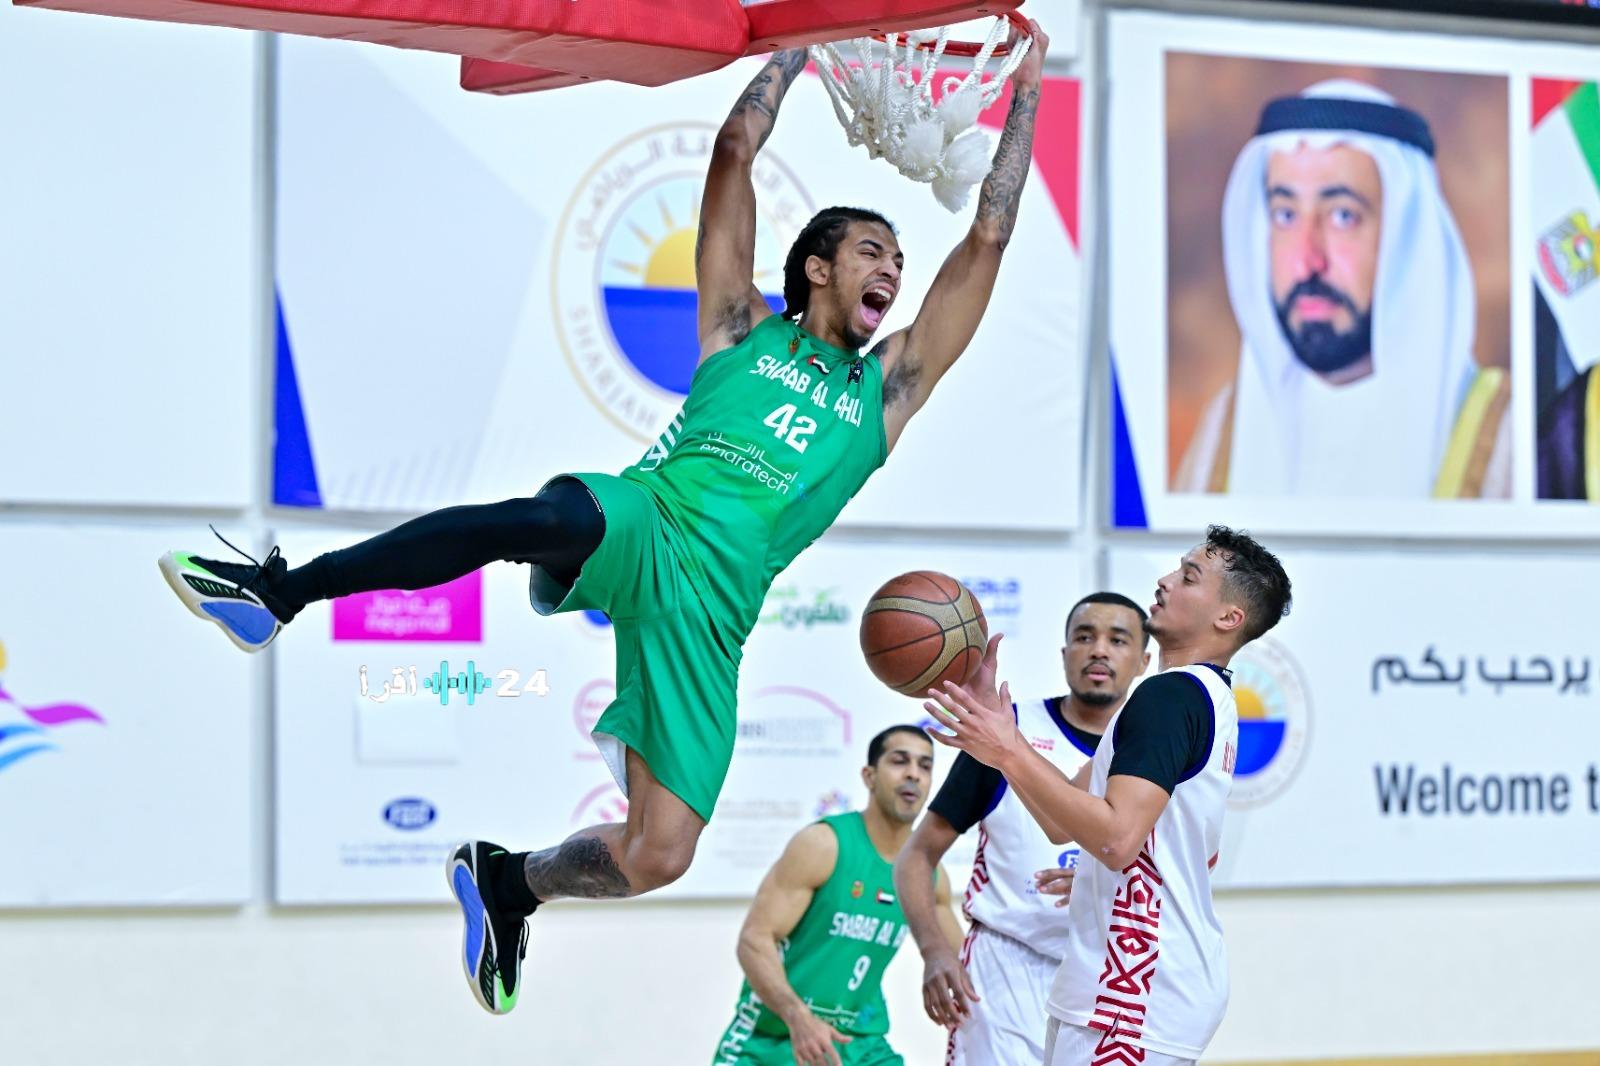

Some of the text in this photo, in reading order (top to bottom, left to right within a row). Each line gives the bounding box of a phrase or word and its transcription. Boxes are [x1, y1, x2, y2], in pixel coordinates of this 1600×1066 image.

[762, 402, 818, 455] 42
[810, 380, 829, 410] AL
[833, 391, 864, 428] AHLI
[699, 442, 790, 496] emaratech
[1370, 642, 1591, 696] يرحب بكم
[1373, 762, 1571, 817] Welcome
[847, 954, 872, 991] 9
